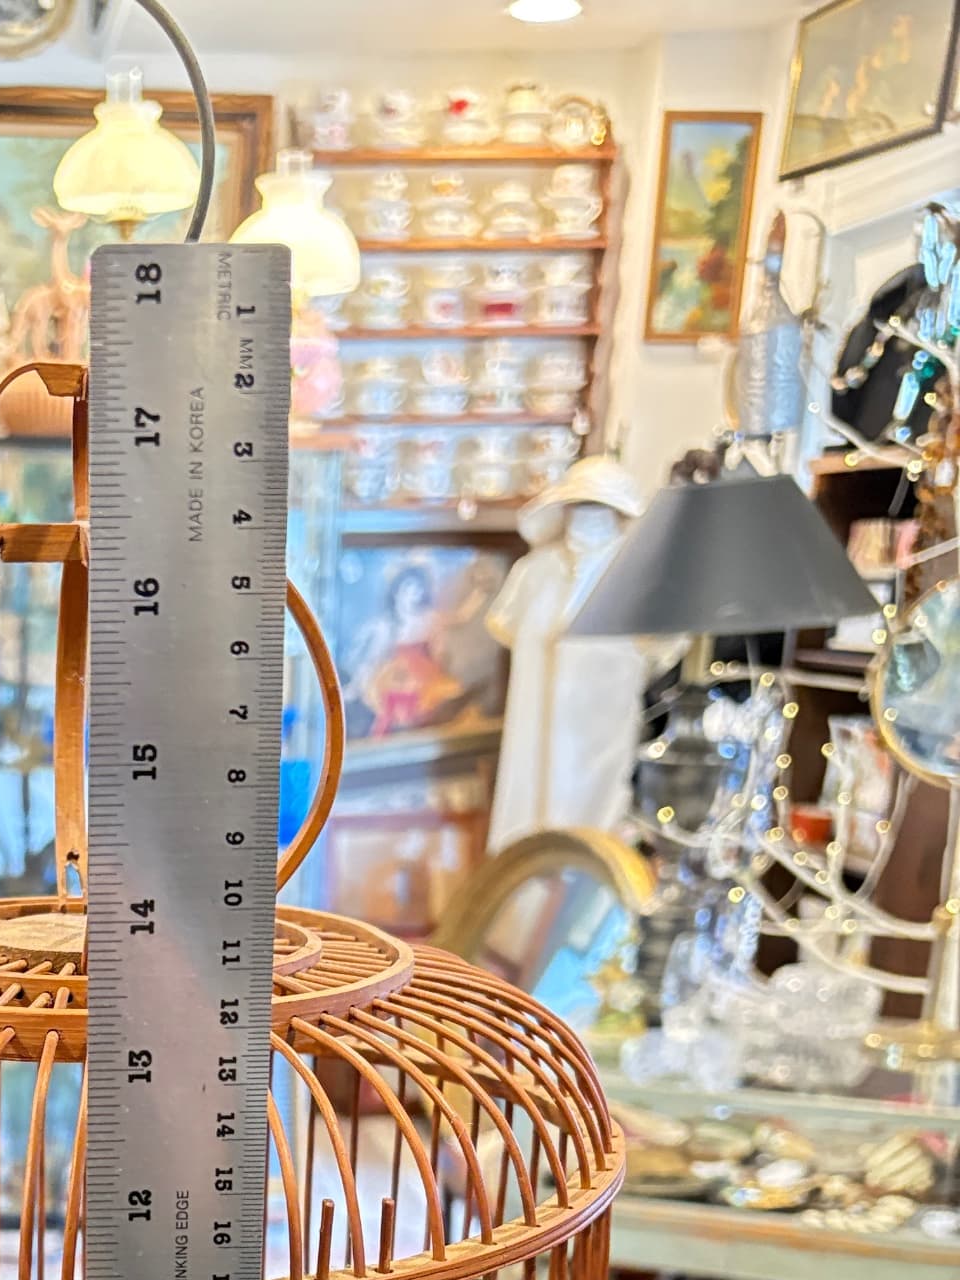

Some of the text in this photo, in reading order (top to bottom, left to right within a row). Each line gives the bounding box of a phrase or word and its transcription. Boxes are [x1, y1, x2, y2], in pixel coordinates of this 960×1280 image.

[135, 263, 162, 303] 18
[216, 252, 232, 320] METRIC
[236, 305, 256, 315] 1
[239, 338, 254, 369] MM
[234, 373, 255, 389] 2
[134, 407, 161, 446] 17
[234, 442, 253, 457] 3
[189, 387, 204, 542] MADE IN KOREA
[233, 509, 252, 524] 4
[231, 576, 251, 590] 5
[133, 577, 160, 616] 16
[230, 640, 250, 655] 6
[229, 705, 249, 720] 7
[132, 744, 157, 780] 15
[227, 769, 246, 783] 8
[225, 831, 245, 846] 9
[223, 879, 243, 907] 10
[130, 899, 155, 935] 14
[222, 940, 241, 965] 11
[219, 998, 239, 1025] 12
[128, 1050, 152, 1083] 13
[218, 1056, 237, 1082] 13
[216, 1112, 235, 1138] 14
[214, 1167, 233, 1191] 15
[128, 1189, 152, 1222] 12
[176, 1190, 190, 1230] EDGE
[213, 1221, 232, 1245] 16
